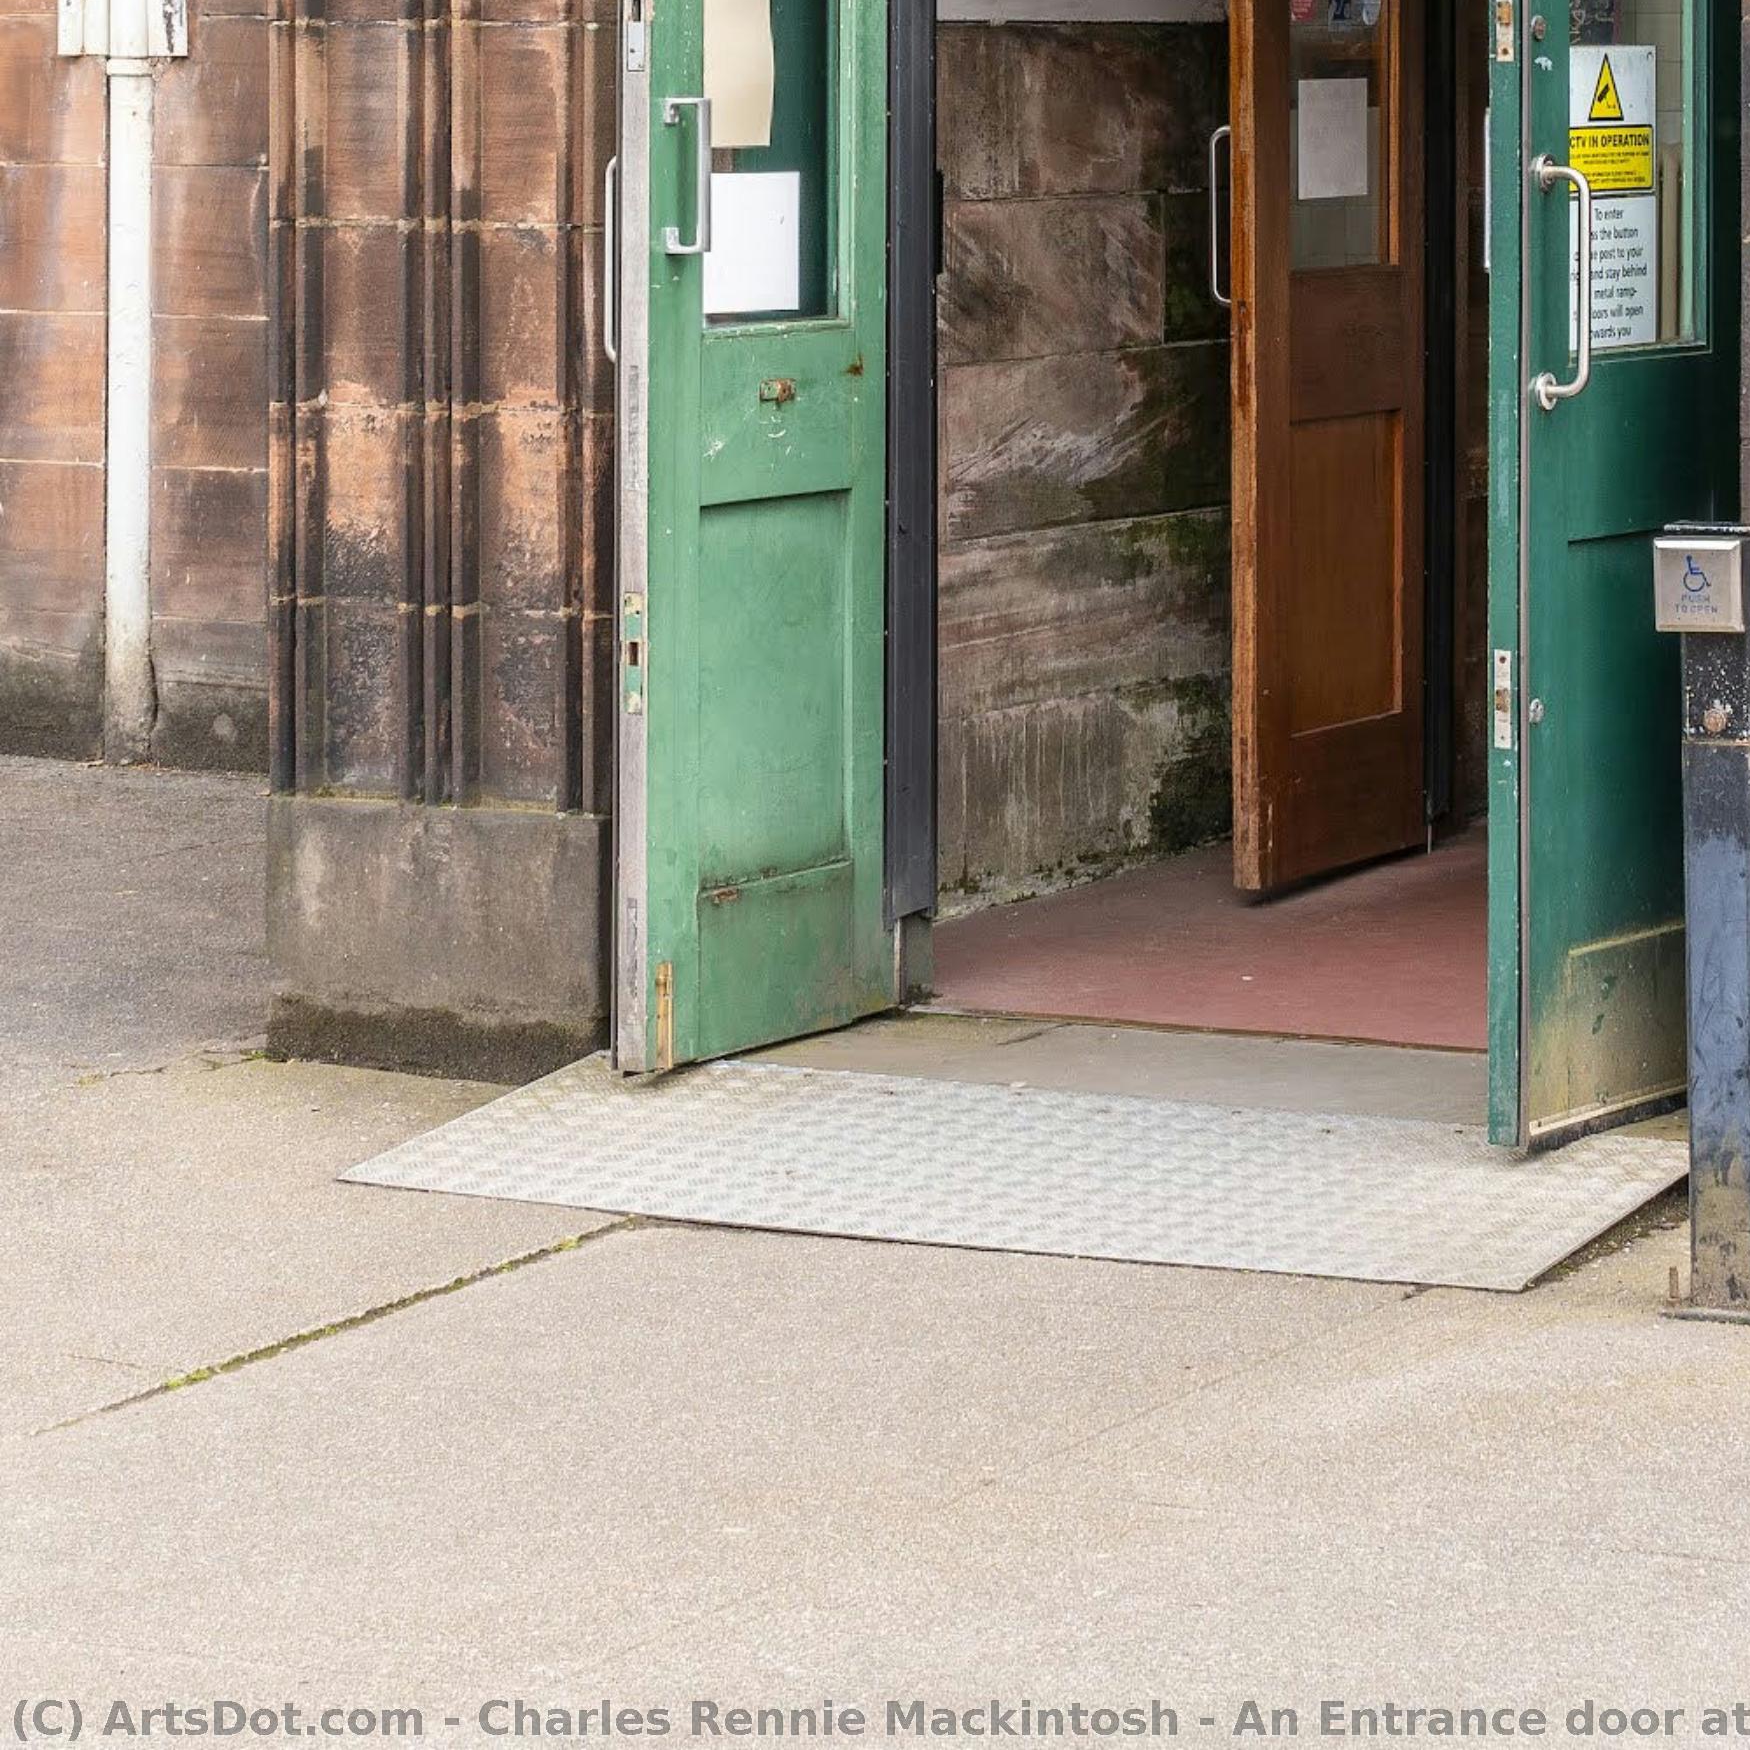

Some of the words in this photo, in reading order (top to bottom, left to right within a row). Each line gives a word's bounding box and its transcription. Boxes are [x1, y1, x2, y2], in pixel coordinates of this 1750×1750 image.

[1569, 135, 1586, 148] CTV
[1589, 135, 1598, 147] IN
[1601, 133, 1649, 147] OPERATION
[1594, 208, 1603, 221] To
[1604, 209, 1624, 220] enter
[1599, 227, 1612, 240] the
[1613, 226, 1639, 240] button
[1599, 249, 1616, 263] post
[1617, 248, 1625, 258] to
[1626, 247, 1643, 262] your
[1605, 268, 1621, 282] stay
[1621, 263, 1648, 278] behind
[1593, 284, 1615, 299] metal
[1592, 308, 1608, 319] oors
[1610, 305, 1623, 317] will
[1625, 306, 1643, 319] open
[1617, 326, 1632, 340] you
[1681, 594, 1710, 603] PUSH
[1690, 604, 1718, 613] OPEN
